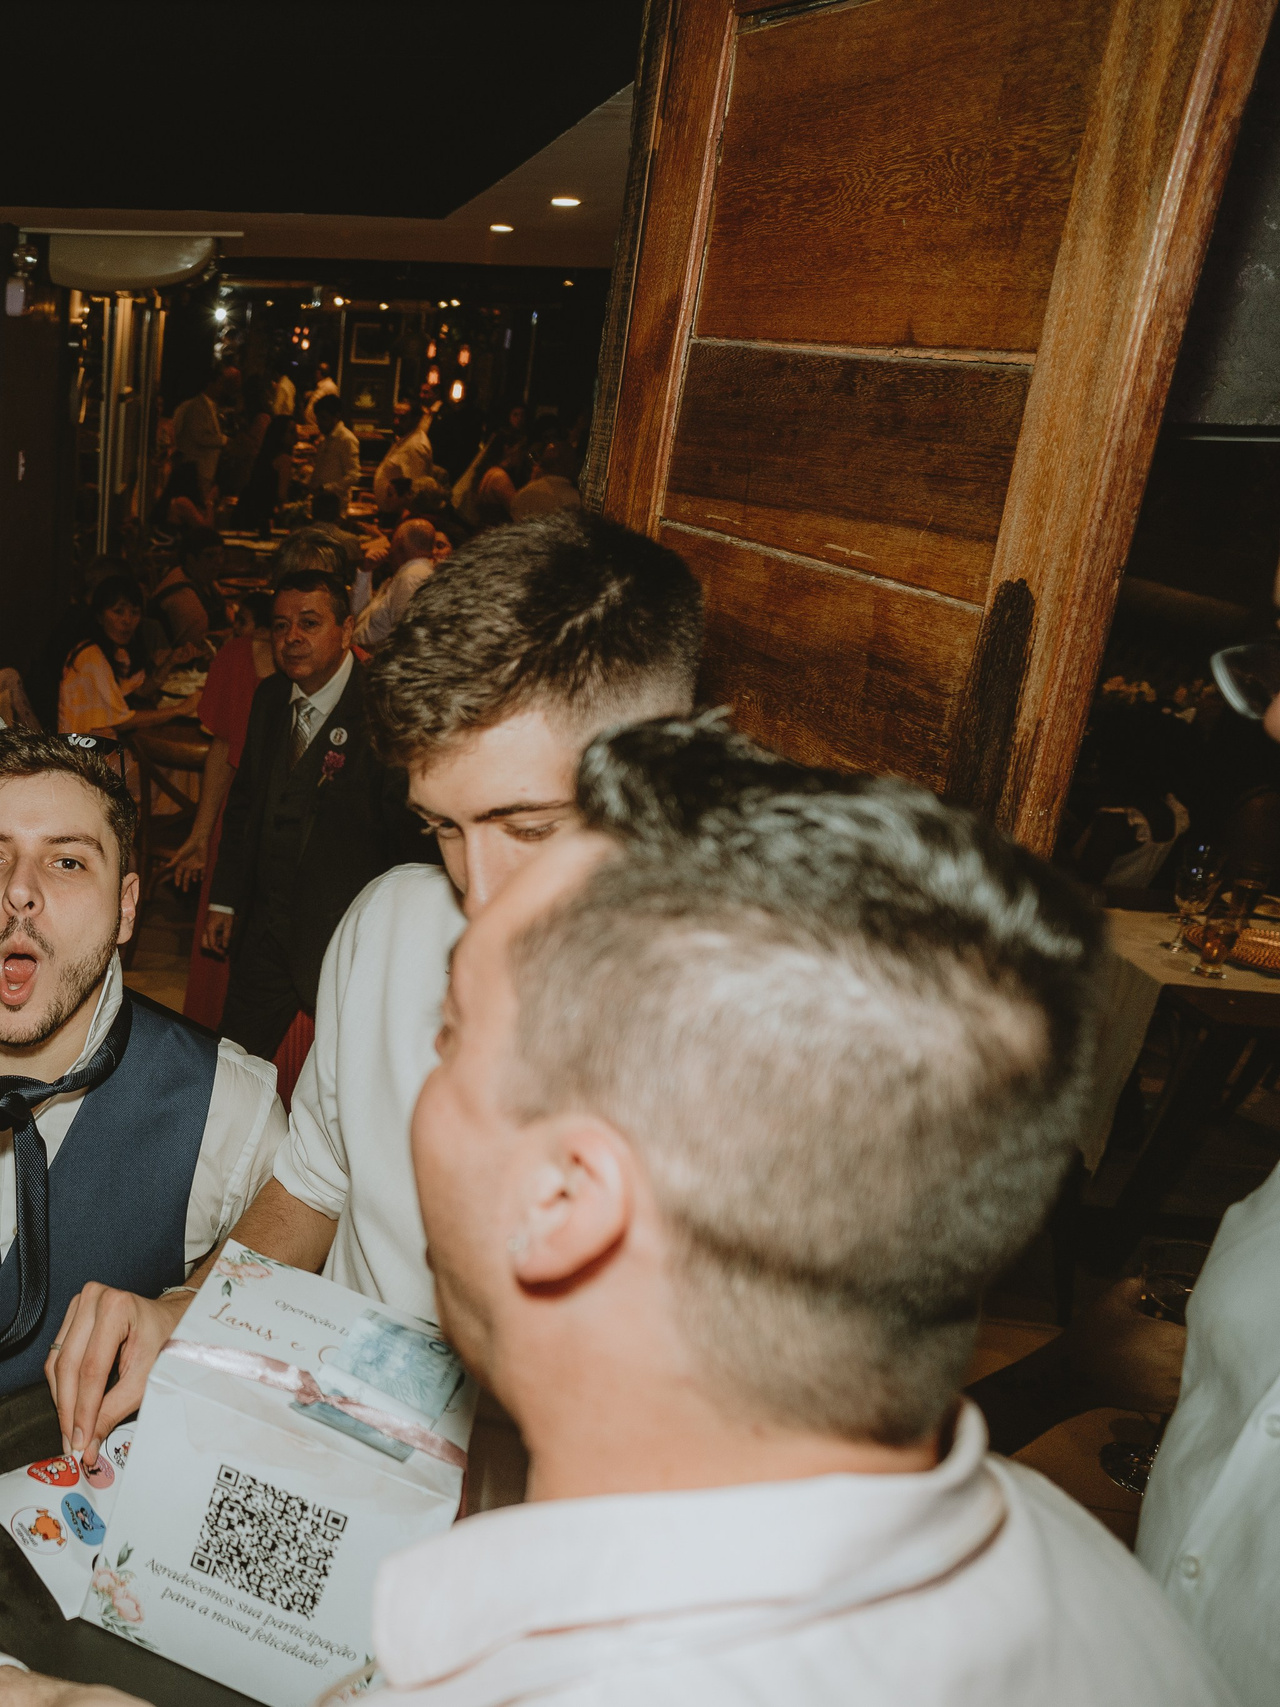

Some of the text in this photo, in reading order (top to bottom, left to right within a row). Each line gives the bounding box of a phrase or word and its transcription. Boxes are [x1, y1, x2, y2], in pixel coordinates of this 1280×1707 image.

[145, 1558, 357, 1662] Agradecemos sua participação
[160, 1587, 329, 1670] para a nossa felicidade!
